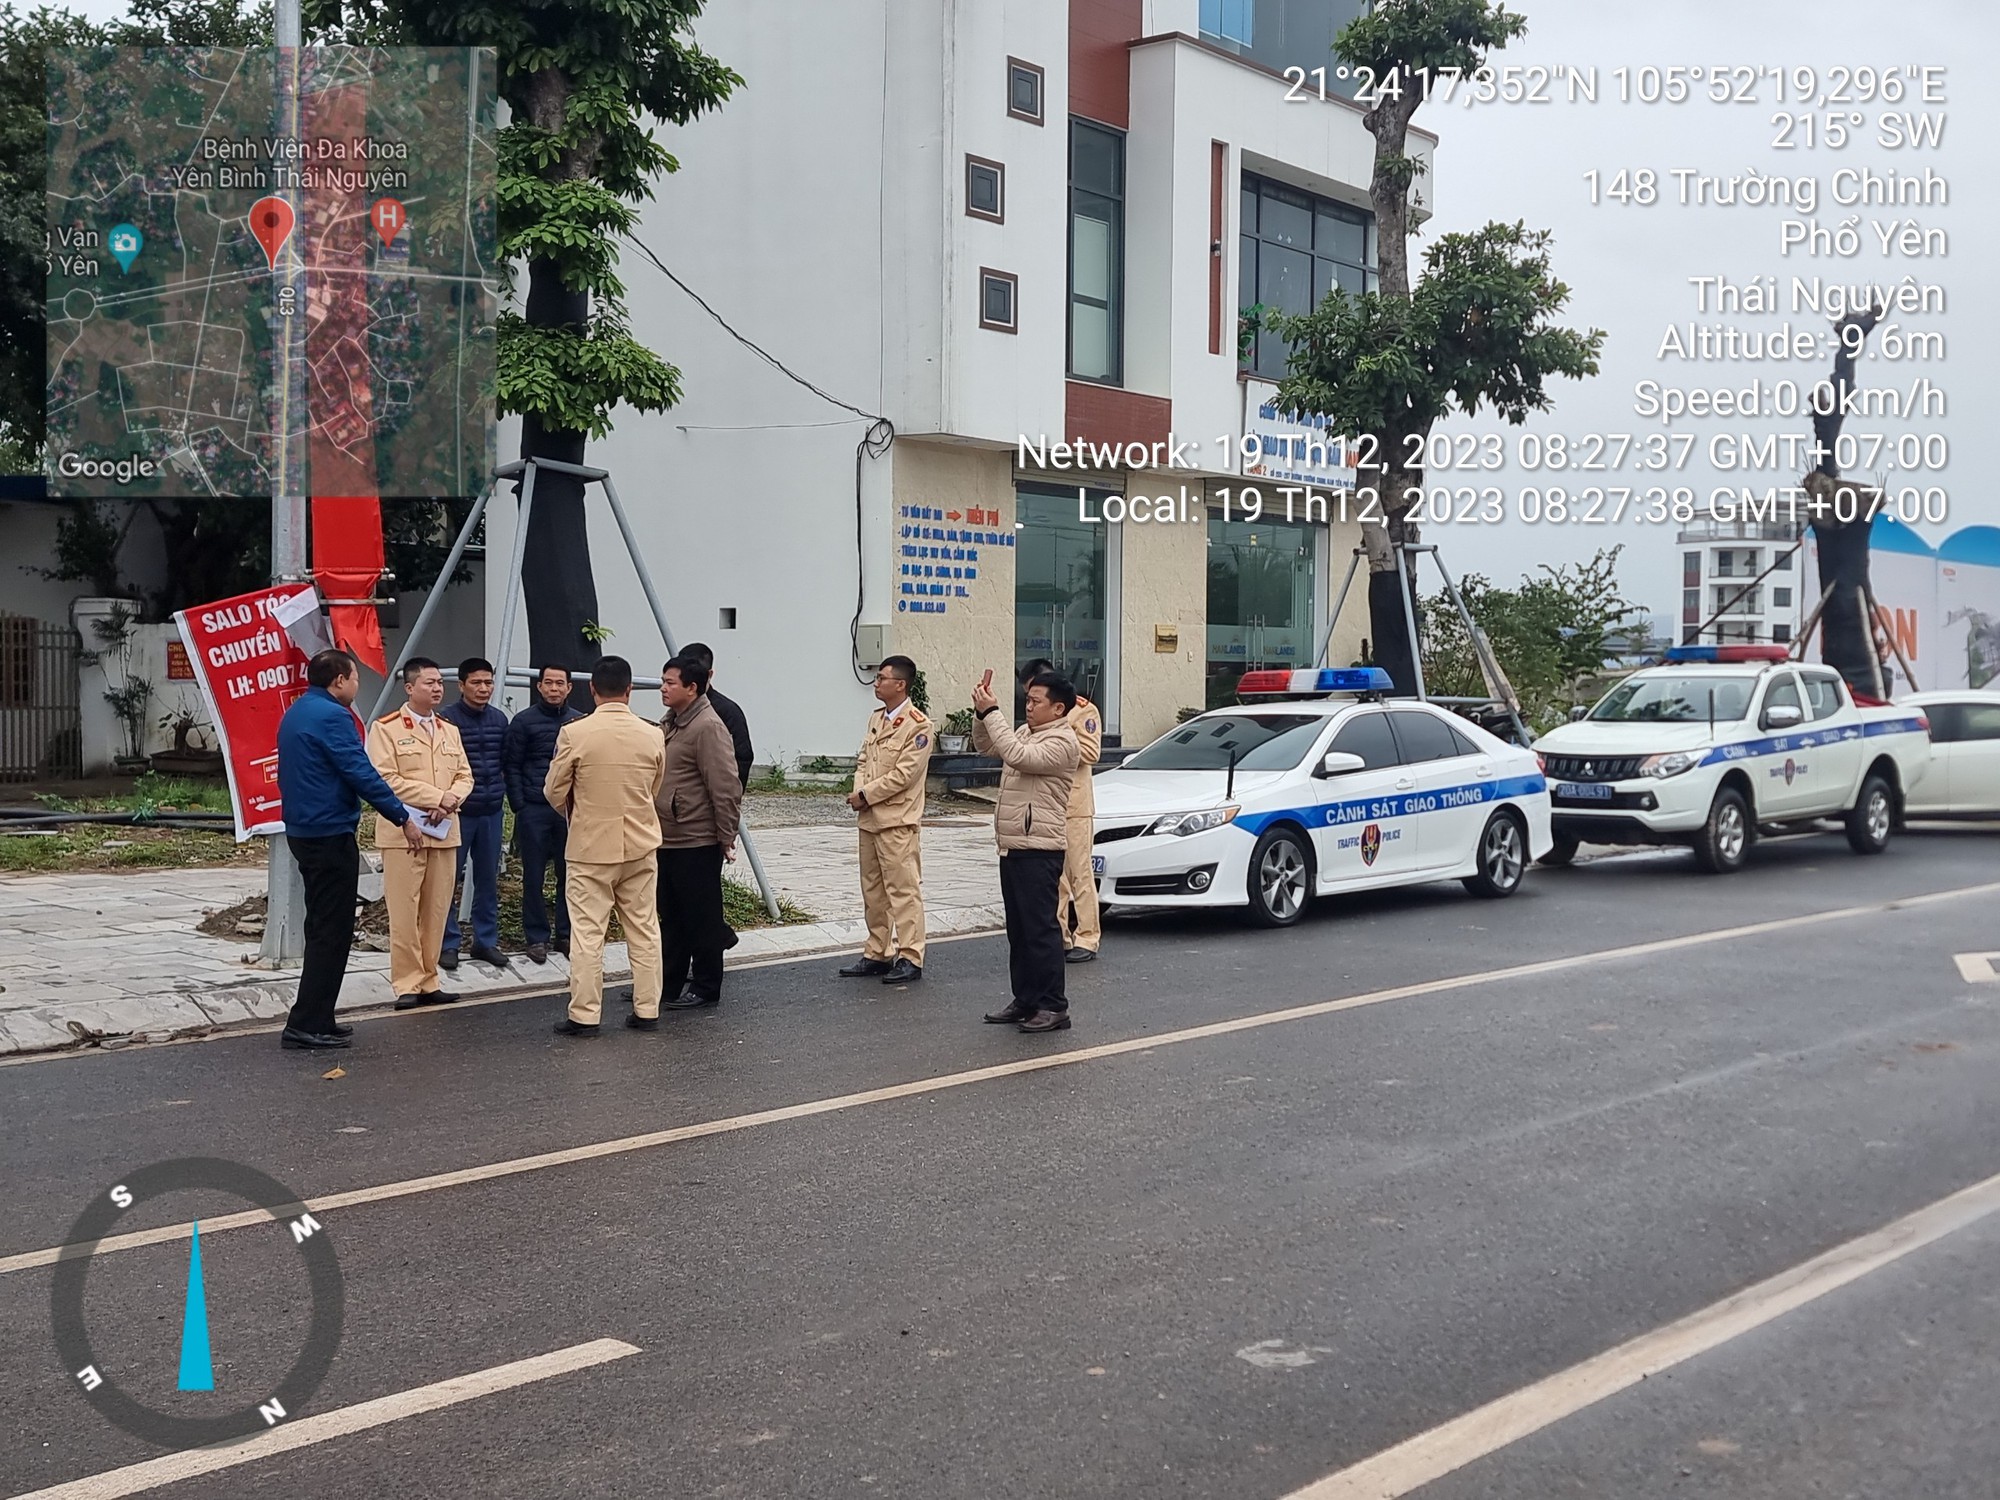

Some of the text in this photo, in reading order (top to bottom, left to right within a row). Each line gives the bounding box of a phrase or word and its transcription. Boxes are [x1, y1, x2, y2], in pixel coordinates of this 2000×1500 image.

[201, 604, 253, 634] SALO
[208, 626, 282, 668] CHUYỂN
[226, 675, 255, 700] LH:
[257, 664, 295, 691] 0907
[1325, 787, 1483, 824] CẢNH SÁT GIAO THÔNG
[1337, 829, 1402, 850] TRAFFIC POLICE
